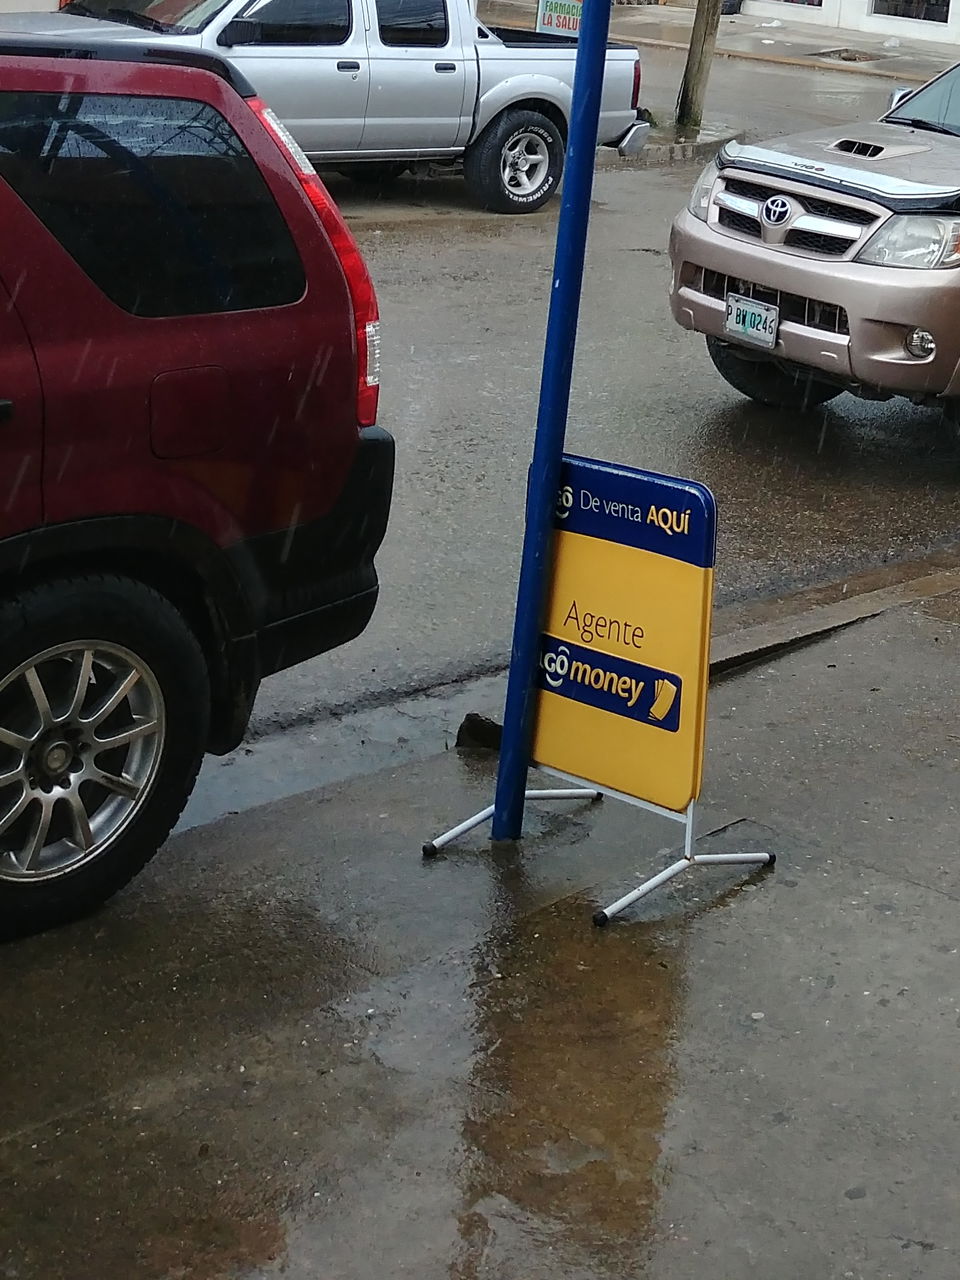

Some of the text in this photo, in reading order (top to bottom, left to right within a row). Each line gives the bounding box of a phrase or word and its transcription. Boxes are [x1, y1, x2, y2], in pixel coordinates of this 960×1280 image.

[542, 12, 552, 27] LA
[750, 312, 774, 334] 0246
[580, 489, 600, 513] De
[603, 499, 642, 523] venta
[646, 505, 691, 536] AQUÍ
[563, 600, 645, 649] Agente
[569, 660, 645, 707] money
